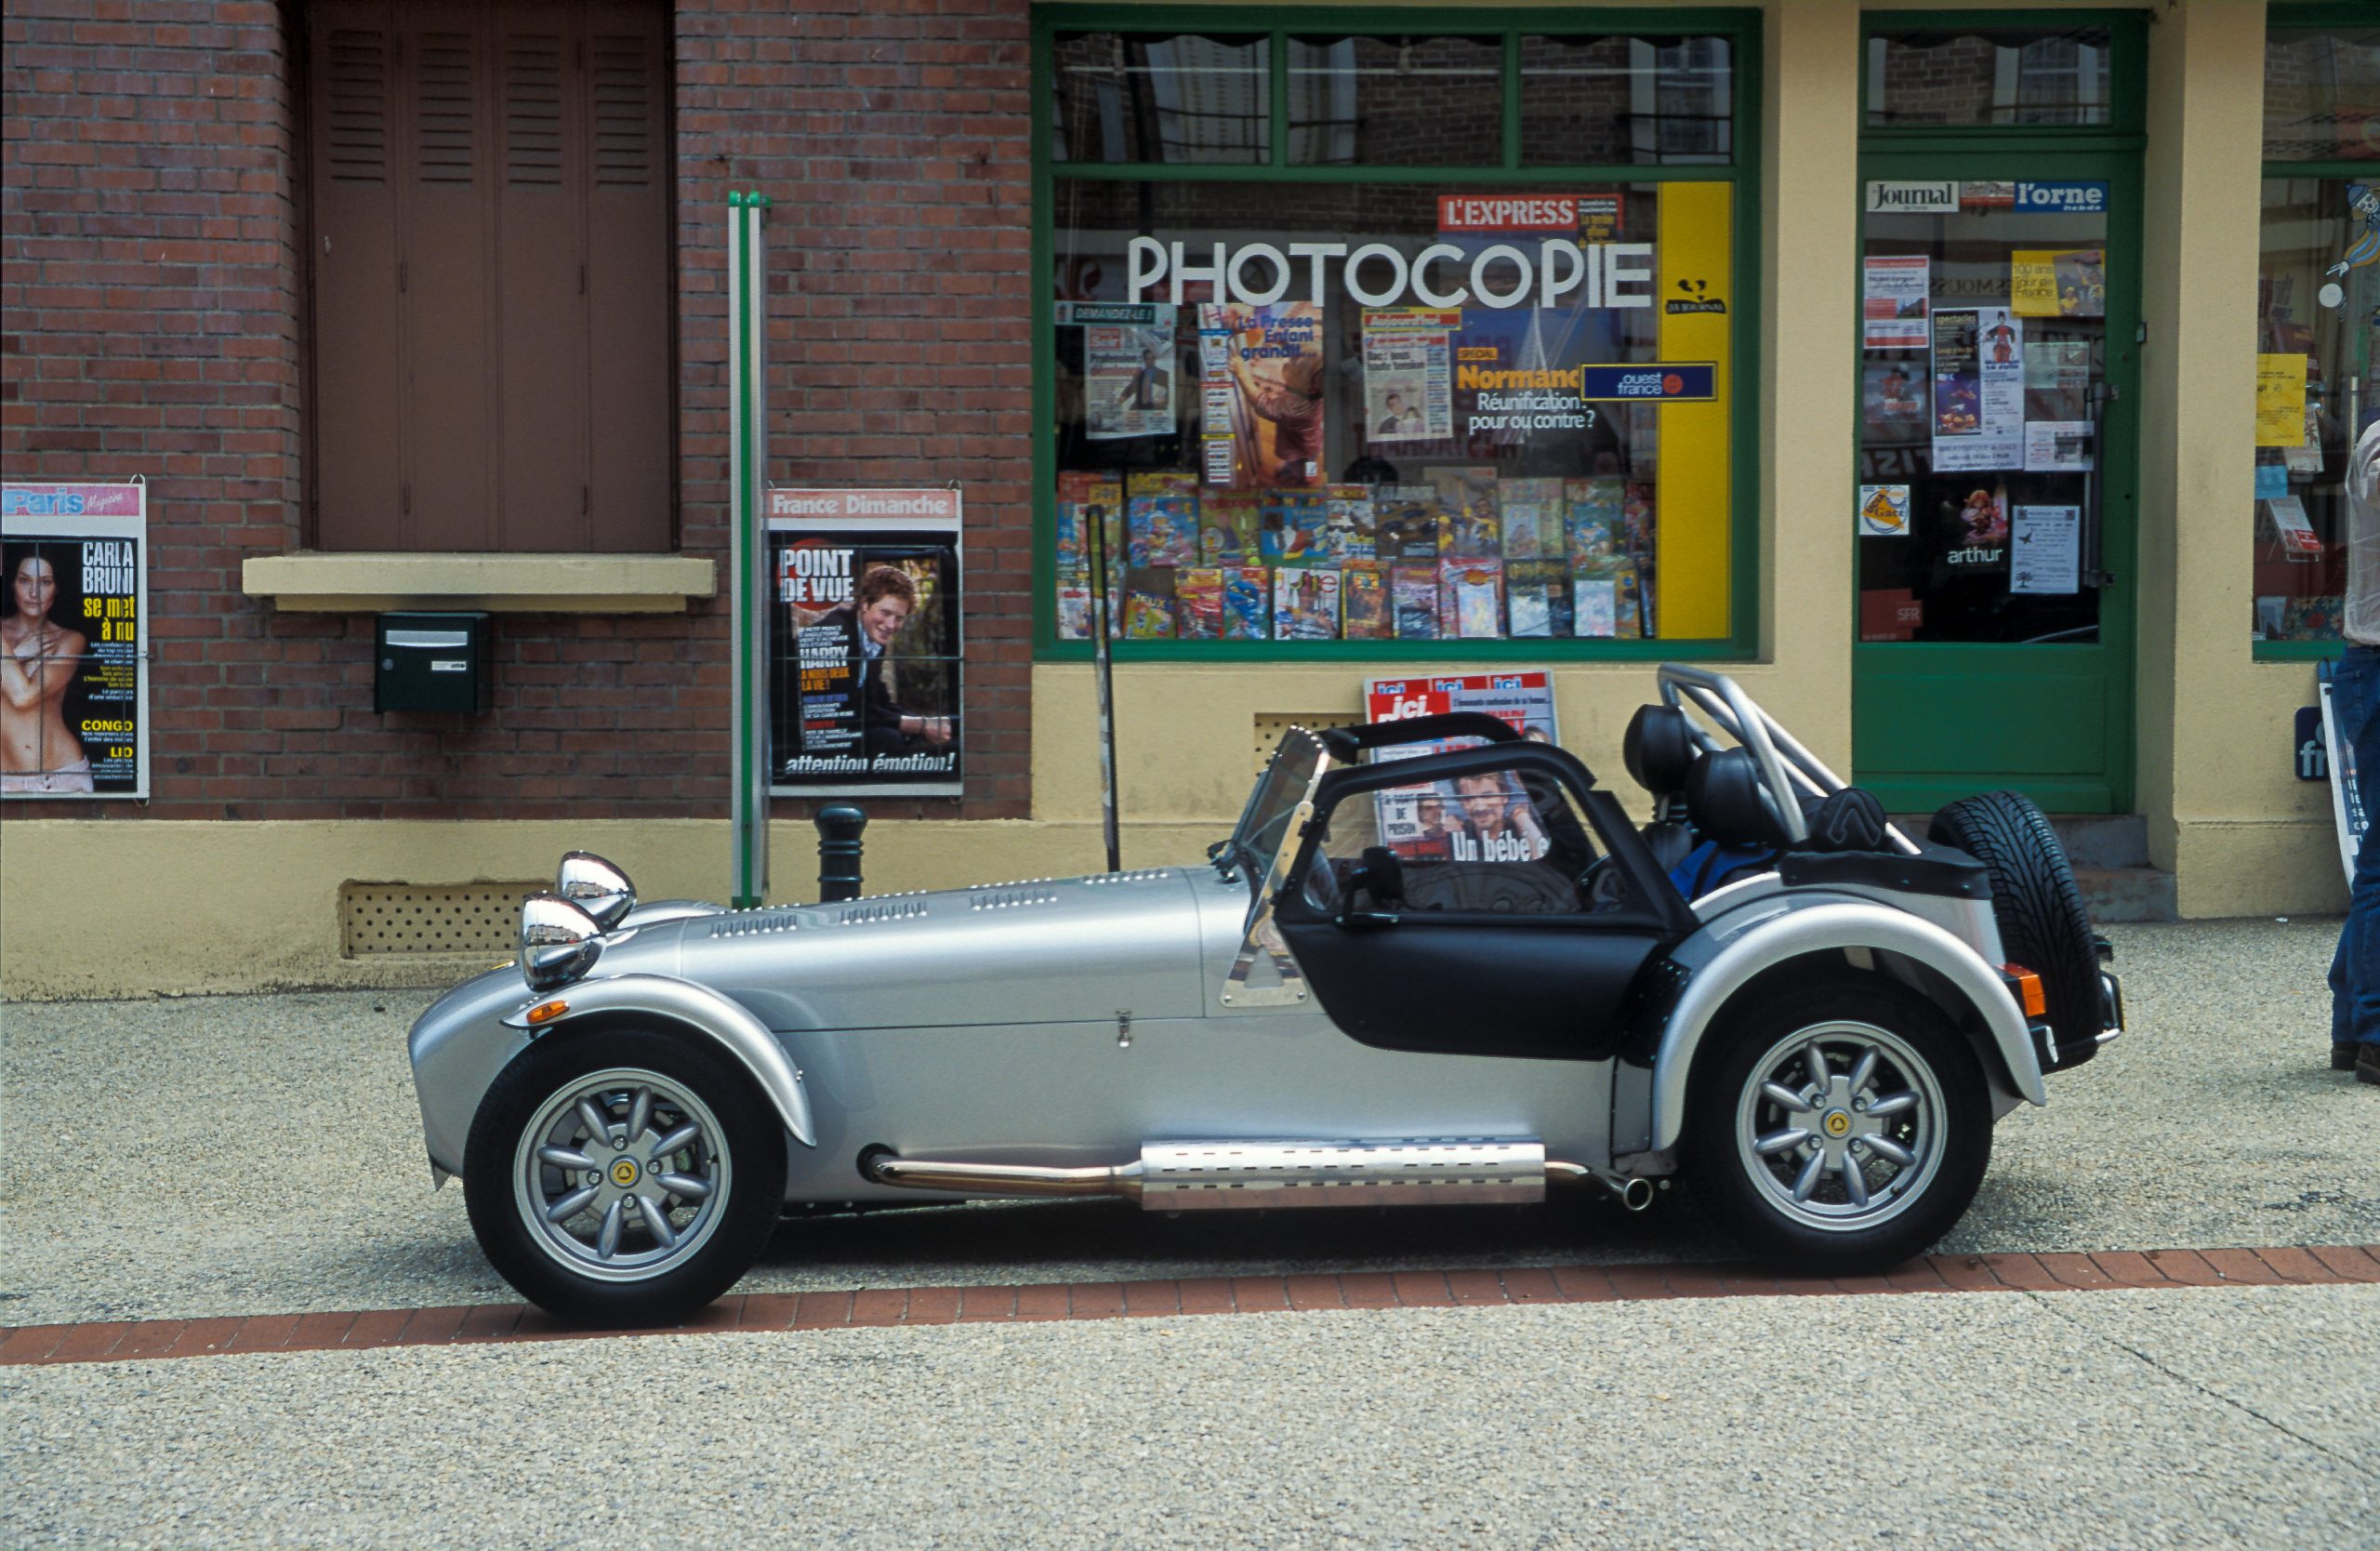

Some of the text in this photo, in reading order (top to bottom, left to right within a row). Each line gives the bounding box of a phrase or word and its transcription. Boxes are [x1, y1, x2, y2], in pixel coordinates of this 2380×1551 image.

[1874, 183, 1953, 210] Journal
[2017, 183, 2102, 205] l'orne
[1448, 199, 1573, 225] L'EXPRESS
[1128, 235, 1652, 309] PHOTOCOPIE
[1239, 317, 1314, 329] La Presse
[1264, 330, 1314, 343] Enfant
[1618, 382, 1662, 395] france
[1624, 373, 1662, 384] ouest
[1469, 416, 1508, 435] pour
[1510, 417, 1532, 429] ou
[3, 488, 86, 515] Paris
[773, 494, 948, 515] France Dimanche
[83, 541, 134, 566] CARLA
[779, 549, 854, 577] POINT
[1948, 546, 2003, 564] arthur
[83, 567, 134, 594] BRUNI
[779, 577, 854, 603] DE VUE
[84, 595, 135, 618] se met
[1897, 607, 1921, 622] SFR
[101, 617, 135, 641] à nu
[82, 720, 134, 732] CONGO
[111, 747, 134, 758] LIO
[787, 754, 869, 772] attention
[1451, 830, 1478, 861] Un
[1483, 829, 1531, 861] bébé
